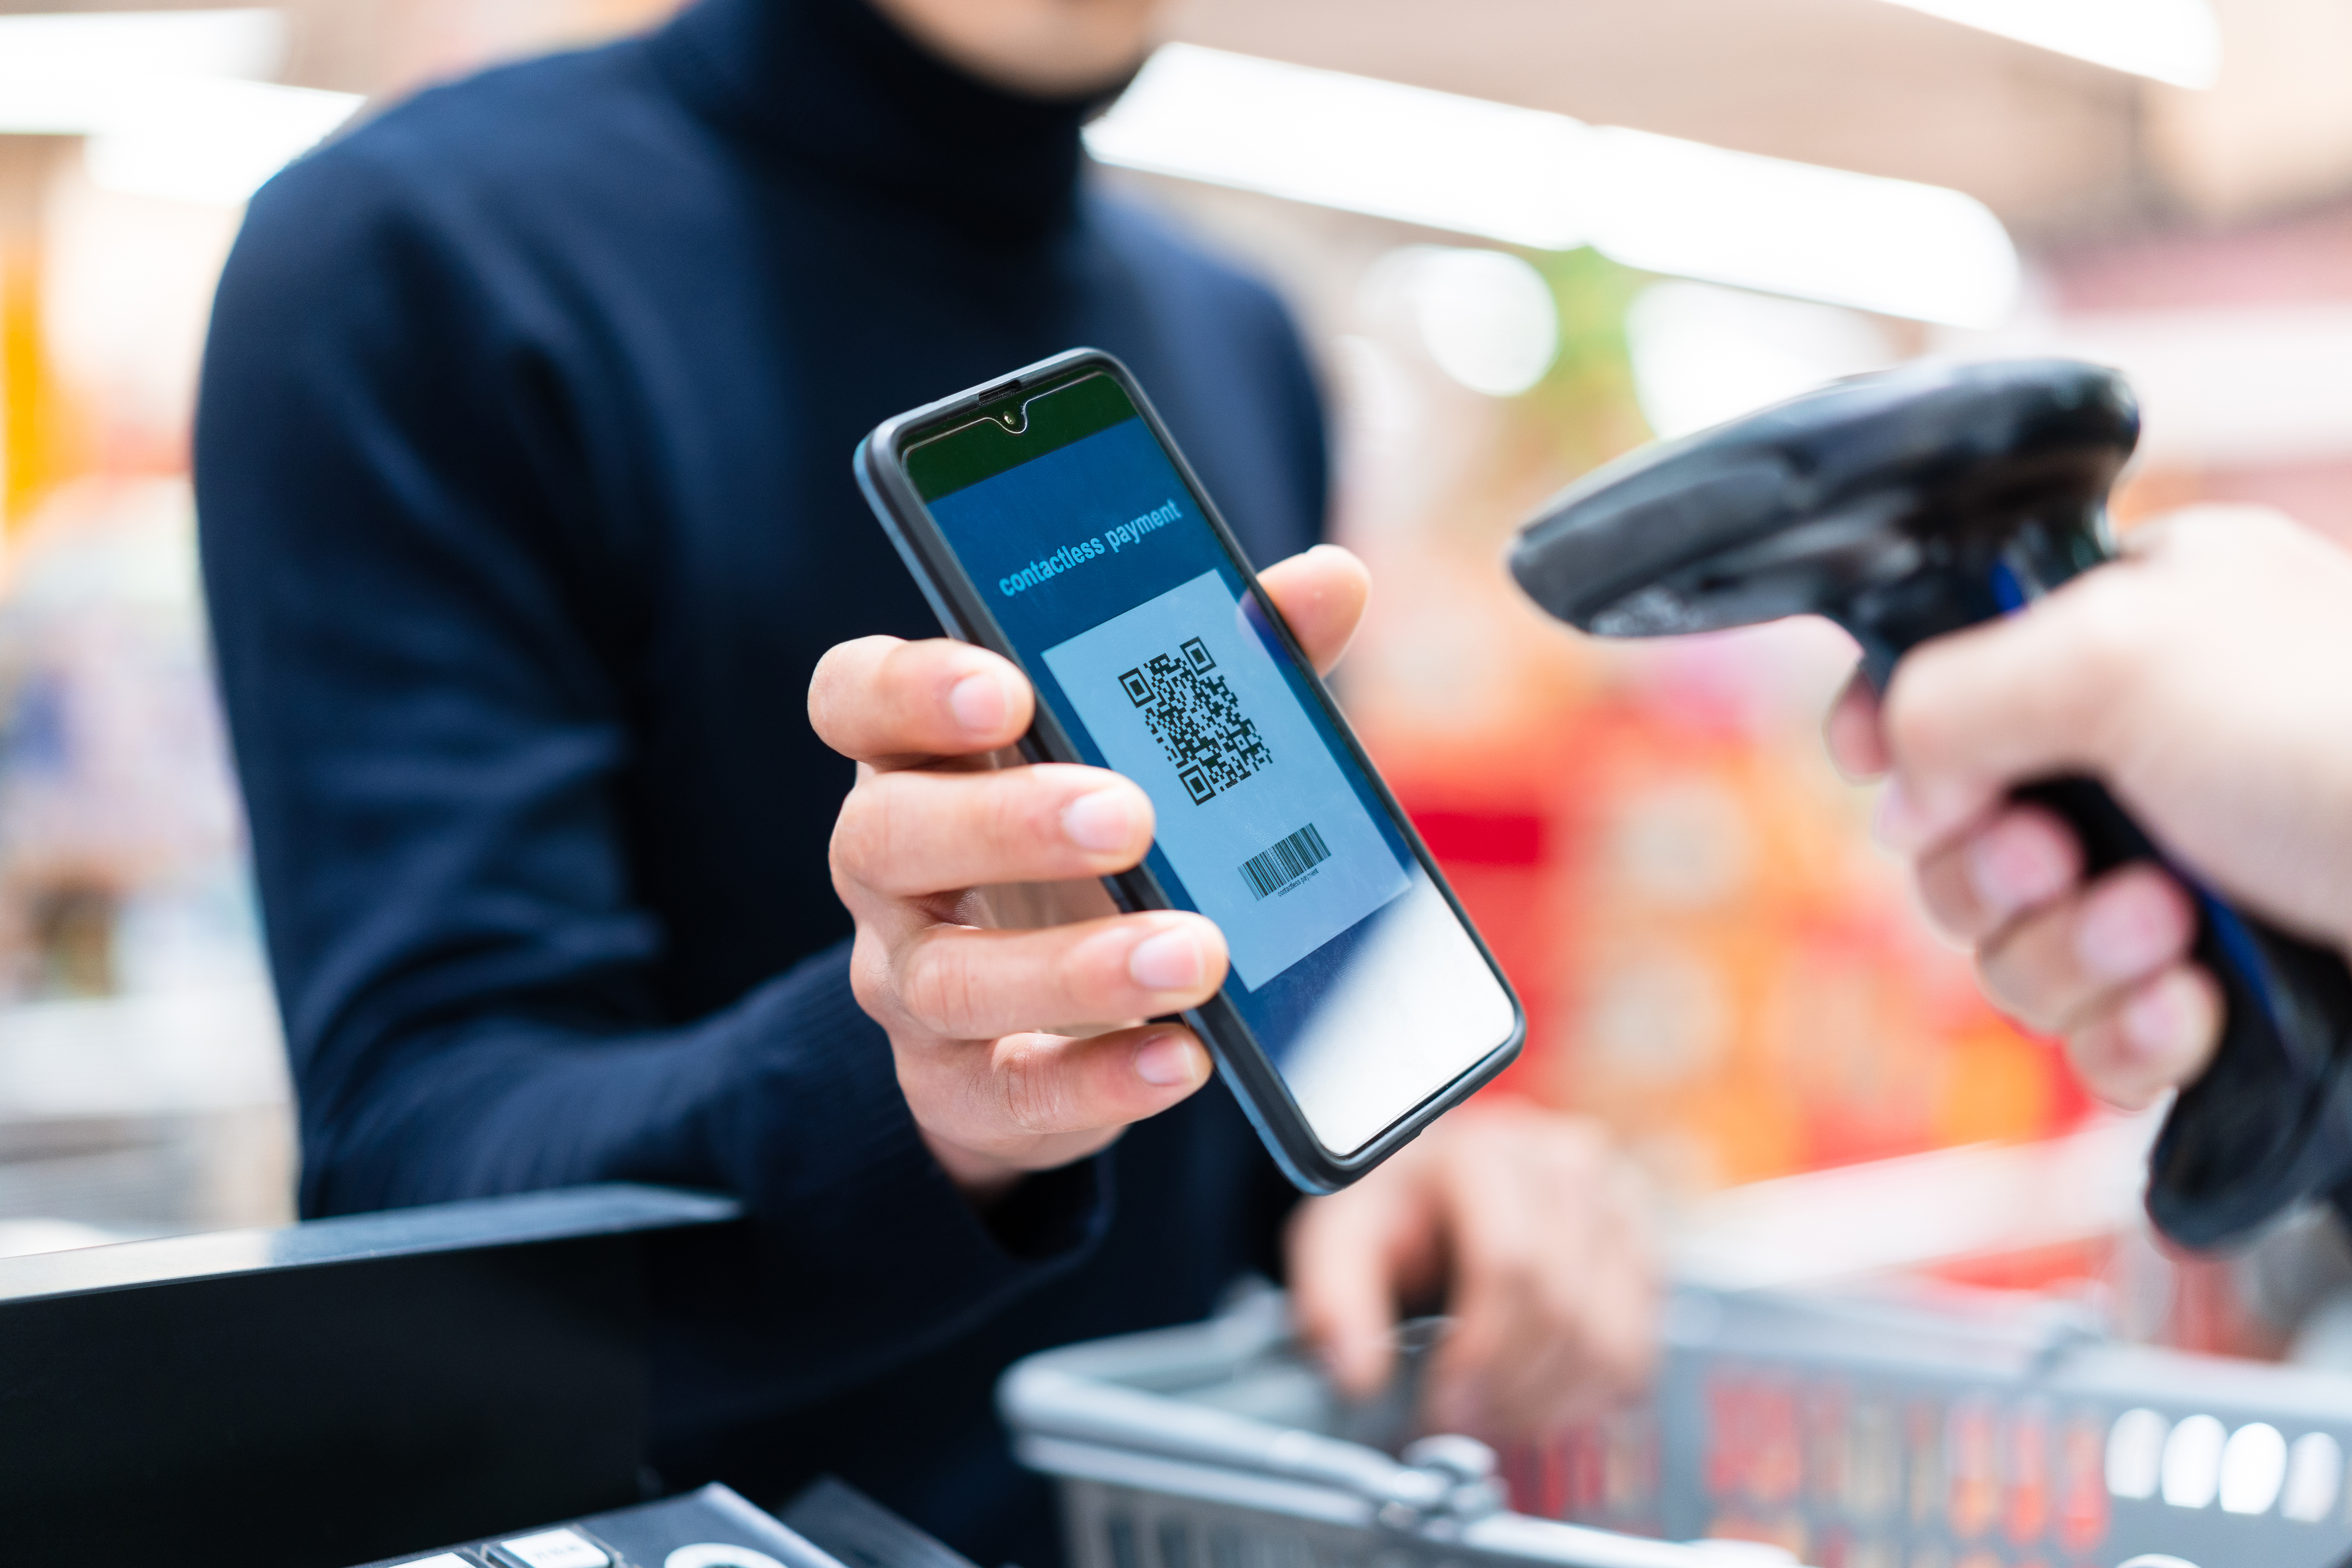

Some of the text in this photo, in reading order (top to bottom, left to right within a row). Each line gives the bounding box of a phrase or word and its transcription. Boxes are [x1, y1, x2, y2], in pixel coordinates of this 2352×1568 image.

[999, 499, 1181, 597] contactless payment
[1278, 868, 1319, 897] contactless payment
